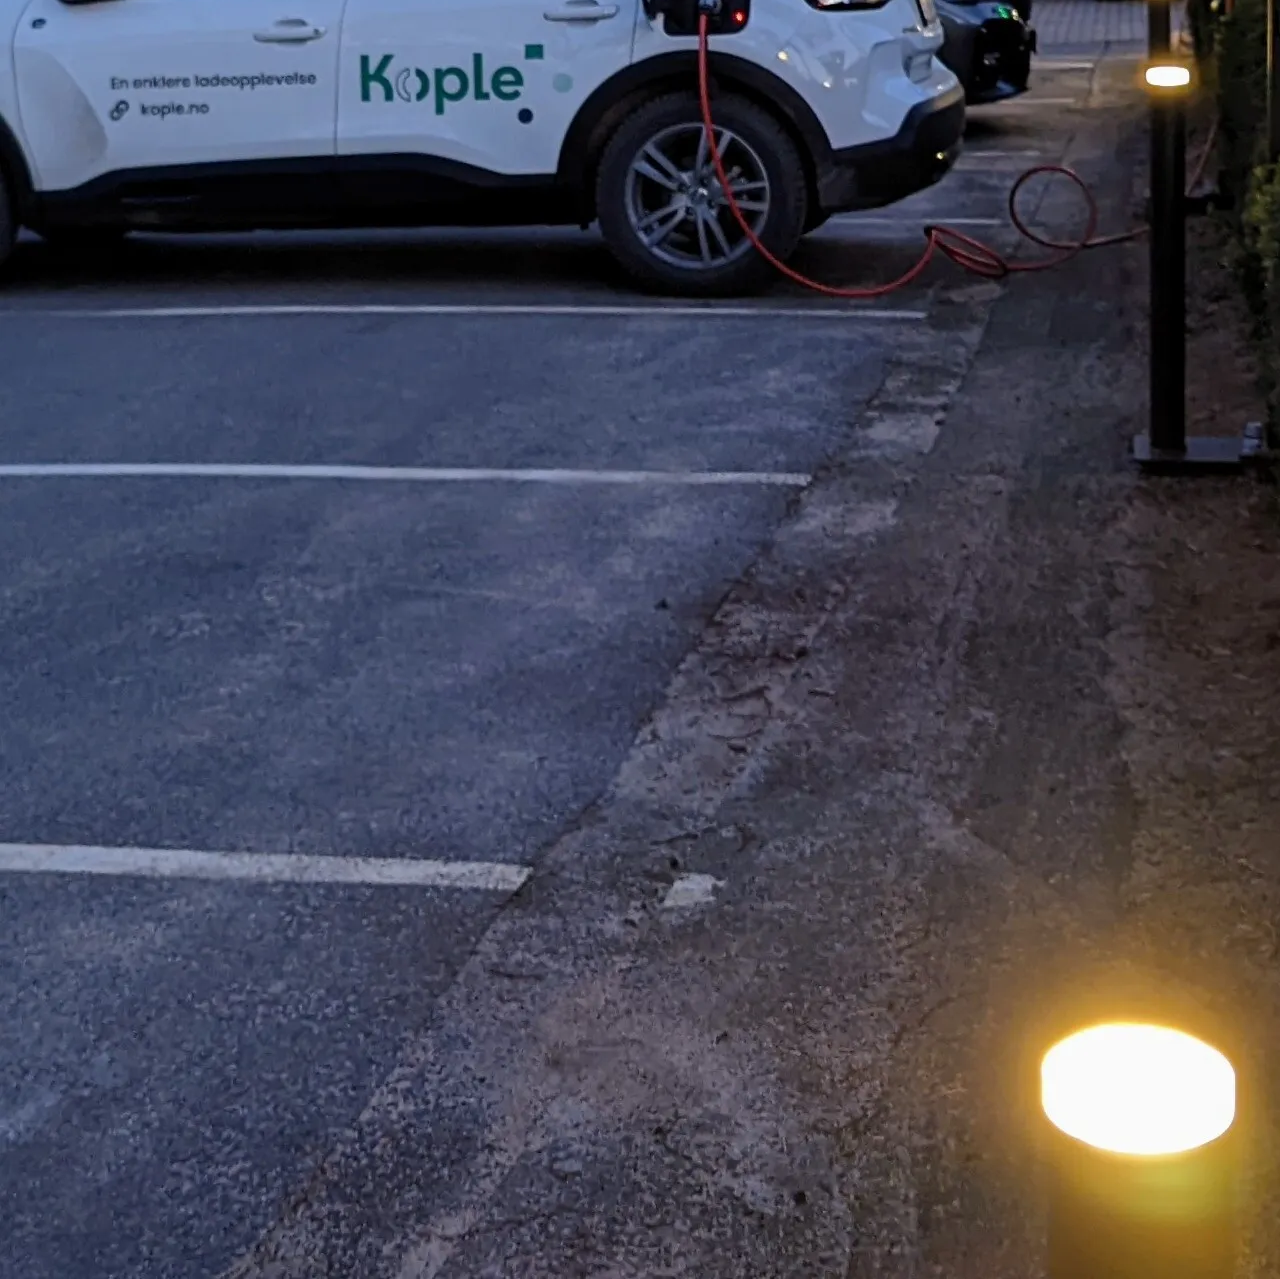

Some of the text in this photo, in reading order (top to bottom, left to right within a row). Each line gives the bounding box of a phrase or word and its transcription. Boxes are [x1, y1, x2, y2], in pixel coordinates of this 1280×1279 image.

[110, 73, 317, 90] En enklere ladeopplevelse
[359, 53, 525, 115] Kople
[140, 102, 210, 120] kople.no
